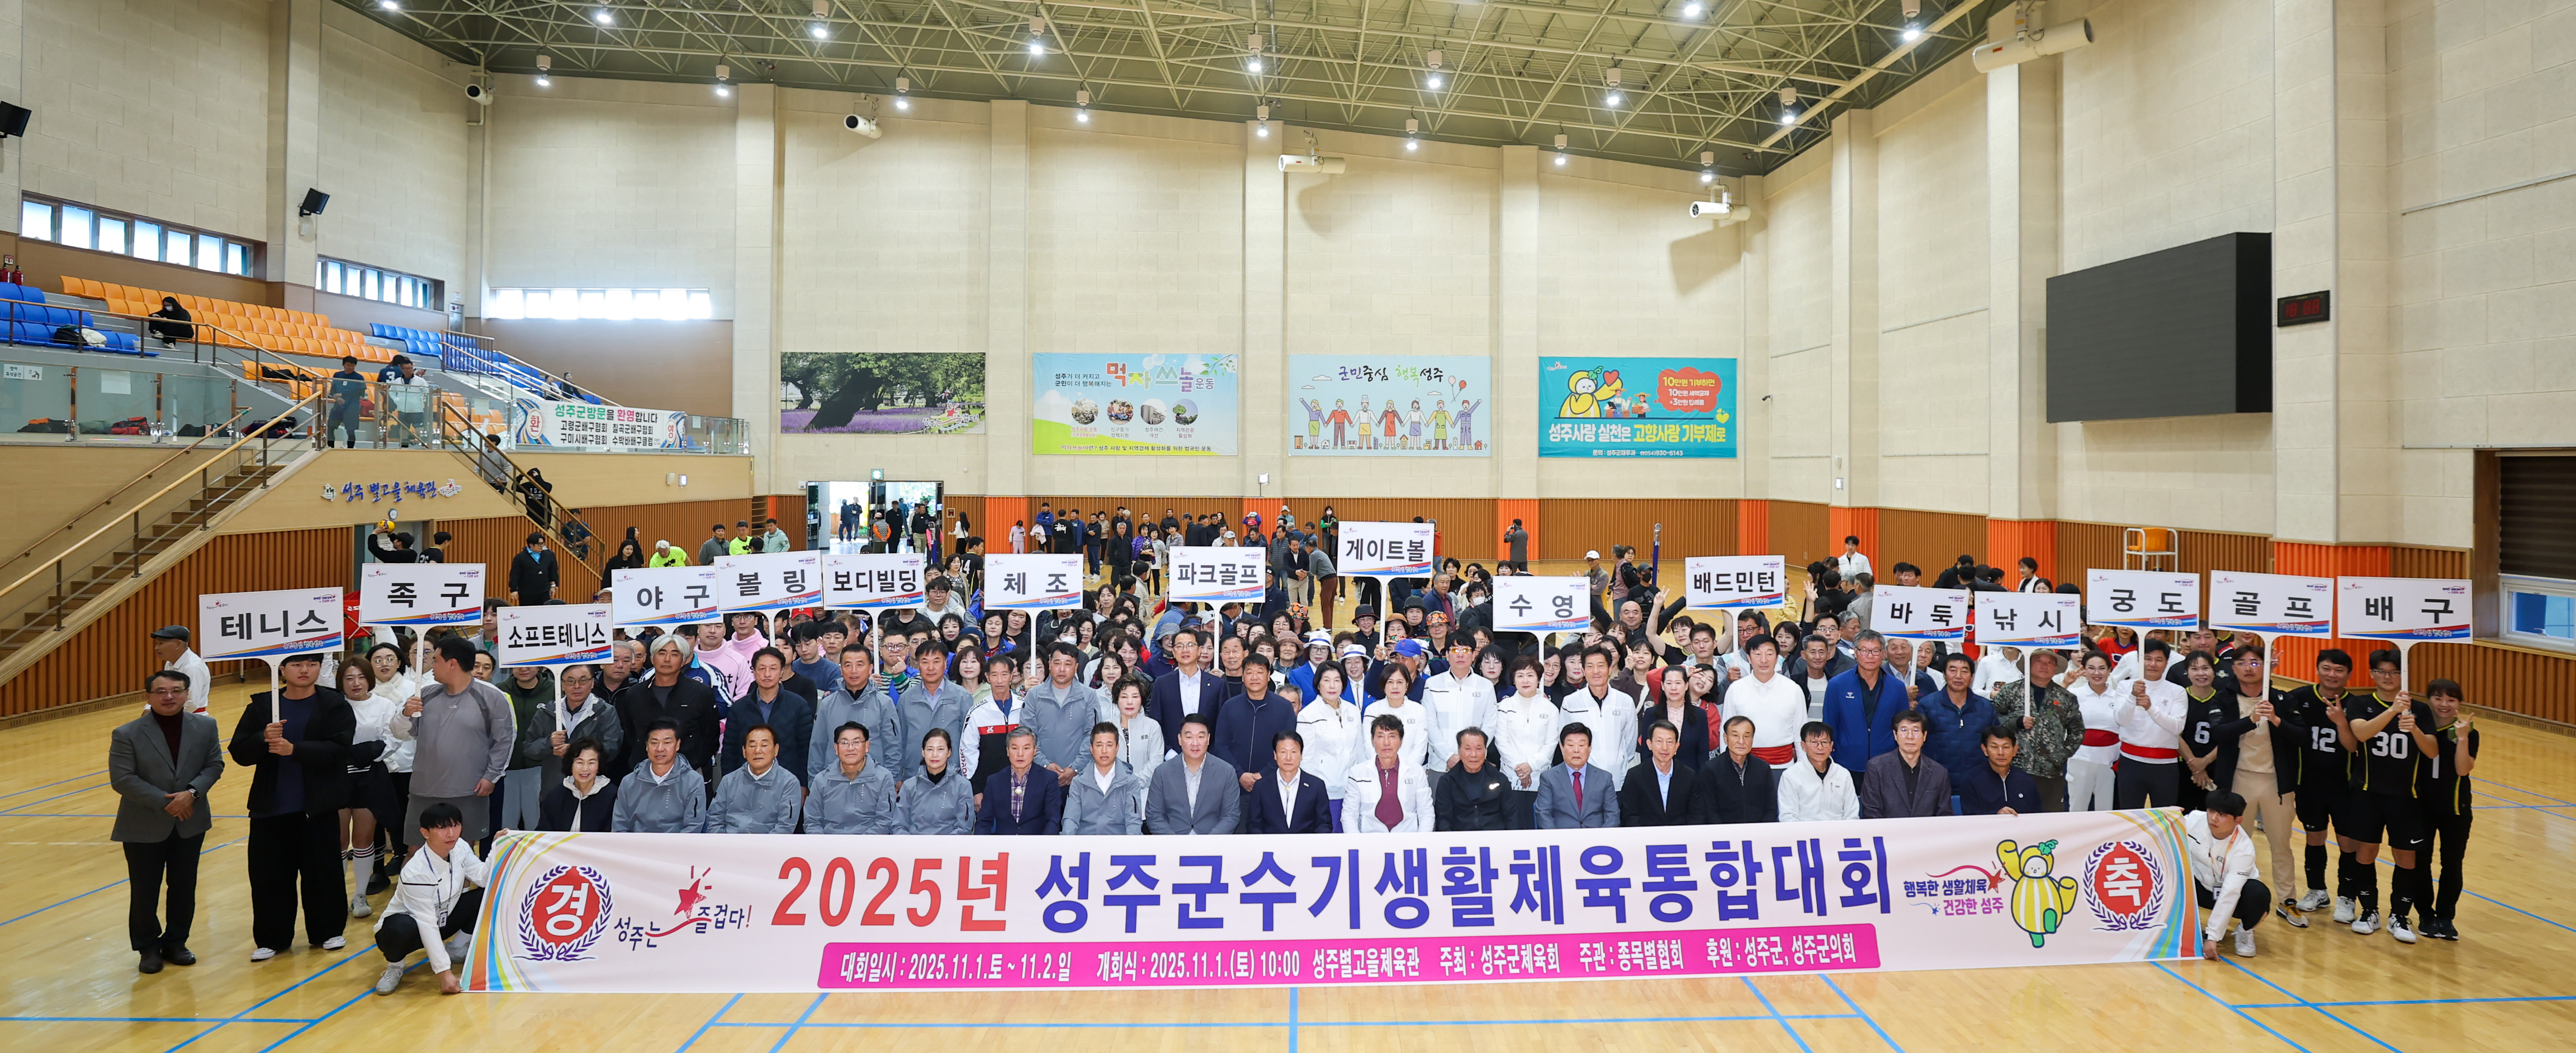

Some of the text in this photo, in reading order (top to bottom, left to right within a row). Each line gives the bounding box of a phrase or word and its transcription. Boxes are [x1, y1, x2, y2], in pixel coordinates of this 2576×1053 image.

[1195, 377, 1214, 389] 운동
[1339, 364, 1443, 388] 군민중심 행복성주
[1663, 376, 1715, 387] 10만원 기부하면
[530, 415, 540, 433] 환
[555, 404, 658, 423] 성주군방문을 환영합니다
[561, 421, 654, 435] 고령군배구협회 칠곡군배구협회
[561, 433, 608, 445] 구미시배구협회
[612, 436, 653, 446] 수박바배구클럽
[667, 425, 674, 439] 영
[1549, 424, 1726, 442] 성주사랑 실천은 고향사랑 기부제로
[342, 481, 363, 502] 성주
[369, 481, 402, 502] 별고을
[405, 481, 438, 498] 체육관
[1346, 538, 1426, 562] 게이트볼
[736, 569, 806, 597] 볼링
[833, 569, 916, 593] 보디빌딩
[1003, 572, 1069, 595] 체조
[1177, 561, 1259, 586] 파크골프
[1693, 570, 1775, 593] 배드민턴
[387, 582, 470, 608] 족구
[637, 585, 709, 610] 야구
[1509, 593, 1573, 618] 수영
[2110, 589, 2185, 613] 궁도
[2232, 591, 2314, 618] 골프
[1890, 602, 1953, 627] 바둑
[2365, 596, 2454, 624] 배구
[221, 610, 329, 640] 테니스
[508, 622, 606, 649] 소프트테니스
[2194, 721, 2210, 744] 6
[2311, 726, 2336, 753] 12
[2371, 732, 2408, 759] 30
[771, 836, 1891, 934] 2025년 성주군수기생활체육통합대회
[1903, 878, 1987, 898] 행복한 생활체육
[2103, 857, 2143, 906] 축
[546, 884, 587, 937] 경
[1943, 897, 2004, 916] 건강한 성주
[614, 904, 751, 951] 성주는 즐겁다!
[1439, 946, 1466, 976] 주최
[1480, 942, 1560, 975] 성주군체육회
[1579, 942, 1606, 972] 주관
[1617, 939, 1684, 972] 종목별협회
[1706, 937, 1732, 968] 후원
[1744, 934, 1789, 969] 성주군,
[1791, 932, 1856, 965] 성주군의회
[840, 951, 896, 984] 대회일시
[909, 952, 1004, 981] 2025.11.1.토
[1021, 951, 1072, 983] 11.2.일
[1096, 951, 1138, 982] 개회식
[1150, 948, 1255, 980] 2025.11.1.(토)
[1260, 950, 1300, 977] 10:00
[1312, 946, 1420, 979] 성주별고을체육관
